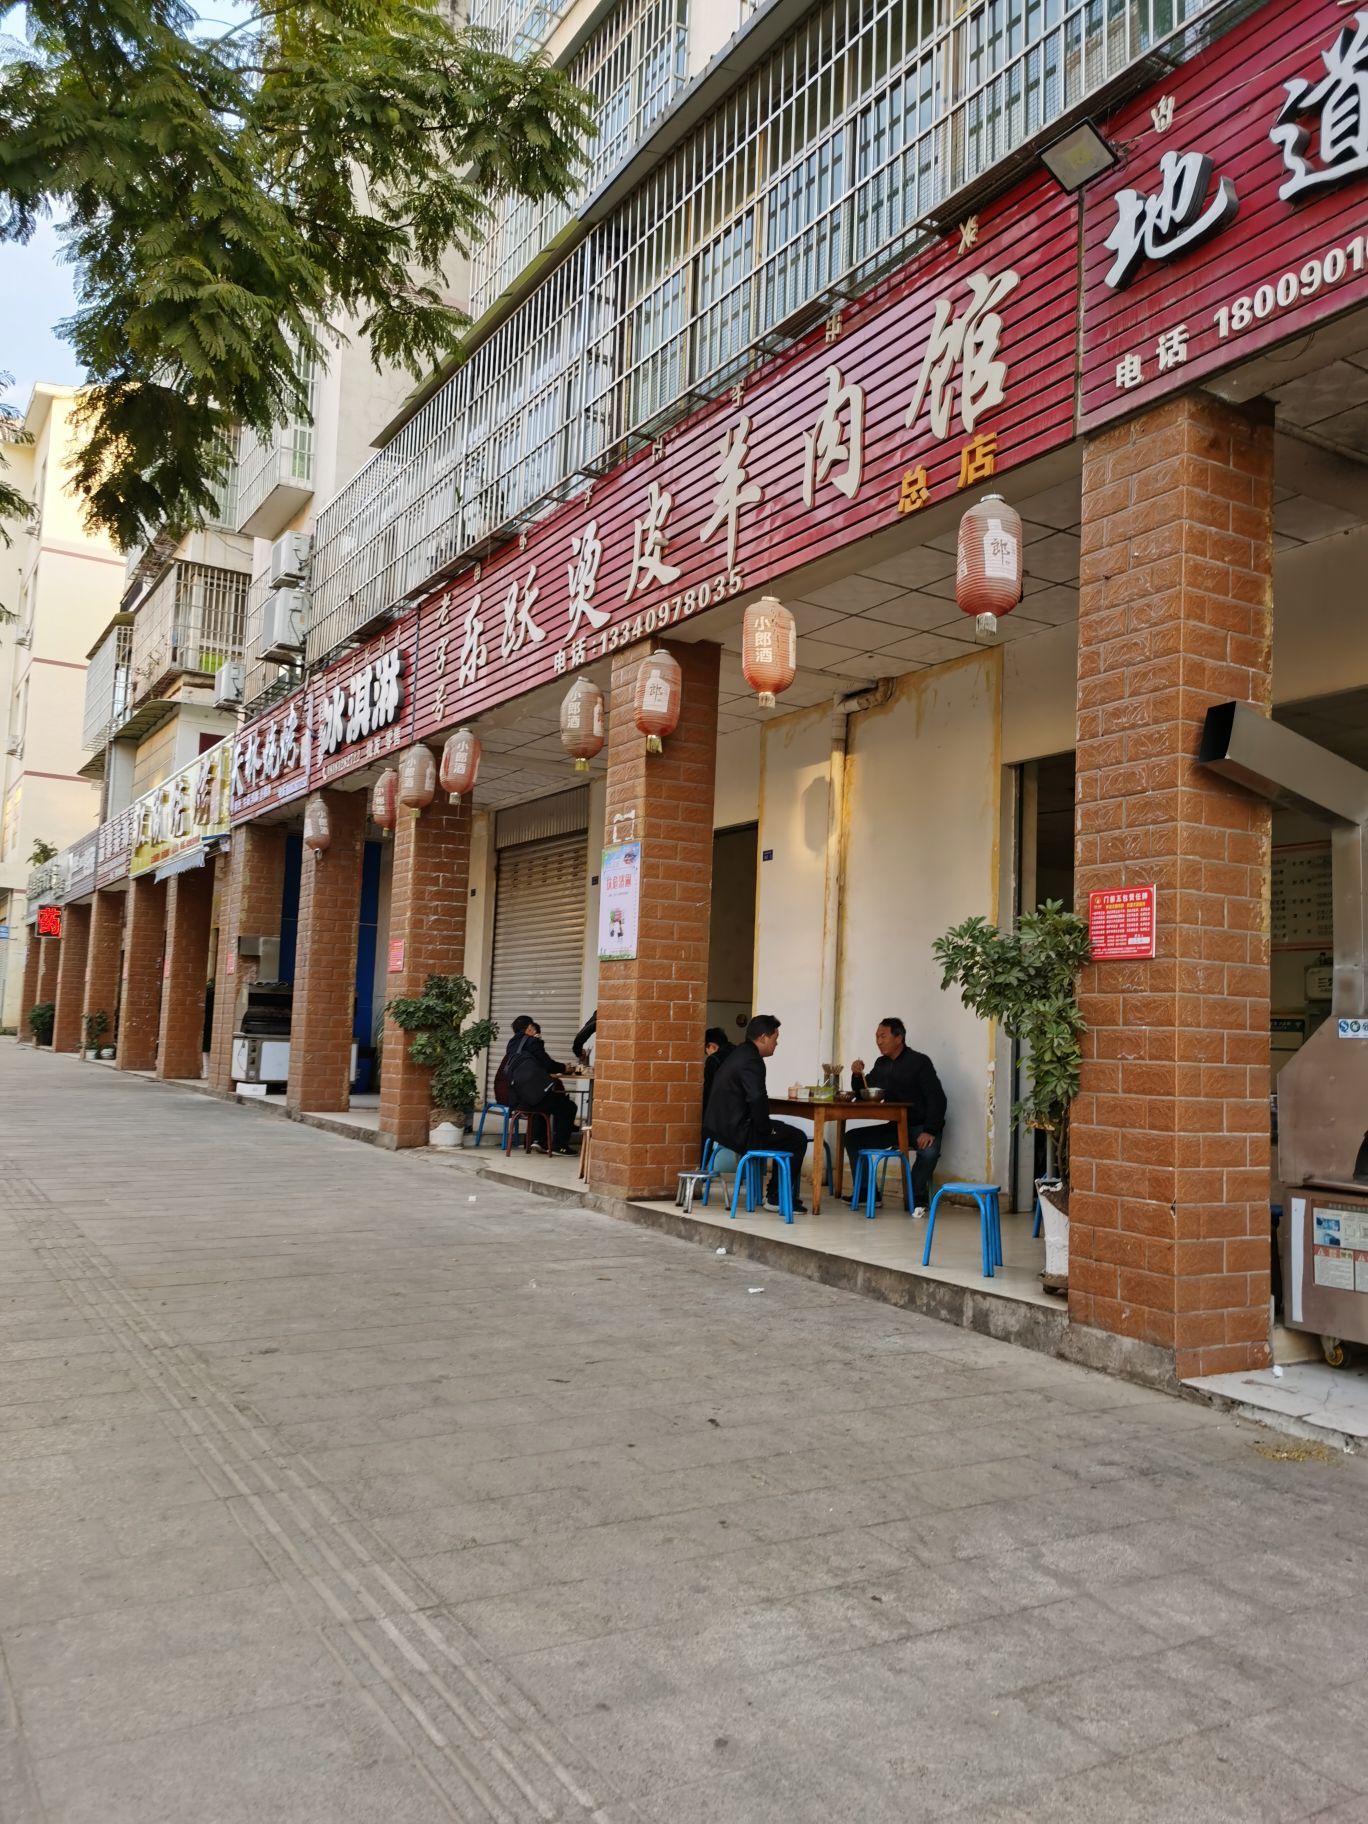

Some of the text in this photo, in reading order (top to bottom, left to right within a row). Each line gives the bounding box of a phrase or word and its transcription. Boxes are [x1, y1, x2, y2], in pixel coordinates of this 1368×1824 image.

[1115, 235, 1368, 389] 电话 1800901
[897, 432, 998, 513] 总店
[990, 538, 1010, 565] 郎
[432, 592, 453, 722] 老字号
[754, 616, 773, 663] 小郎酒
[321, 648, 402, 754] 冰淇淋
[567, 691, 581, 729] 小郎酒
[453, 742, 470, 775] 小郎酒
[39, 907, 61, 935] 药
